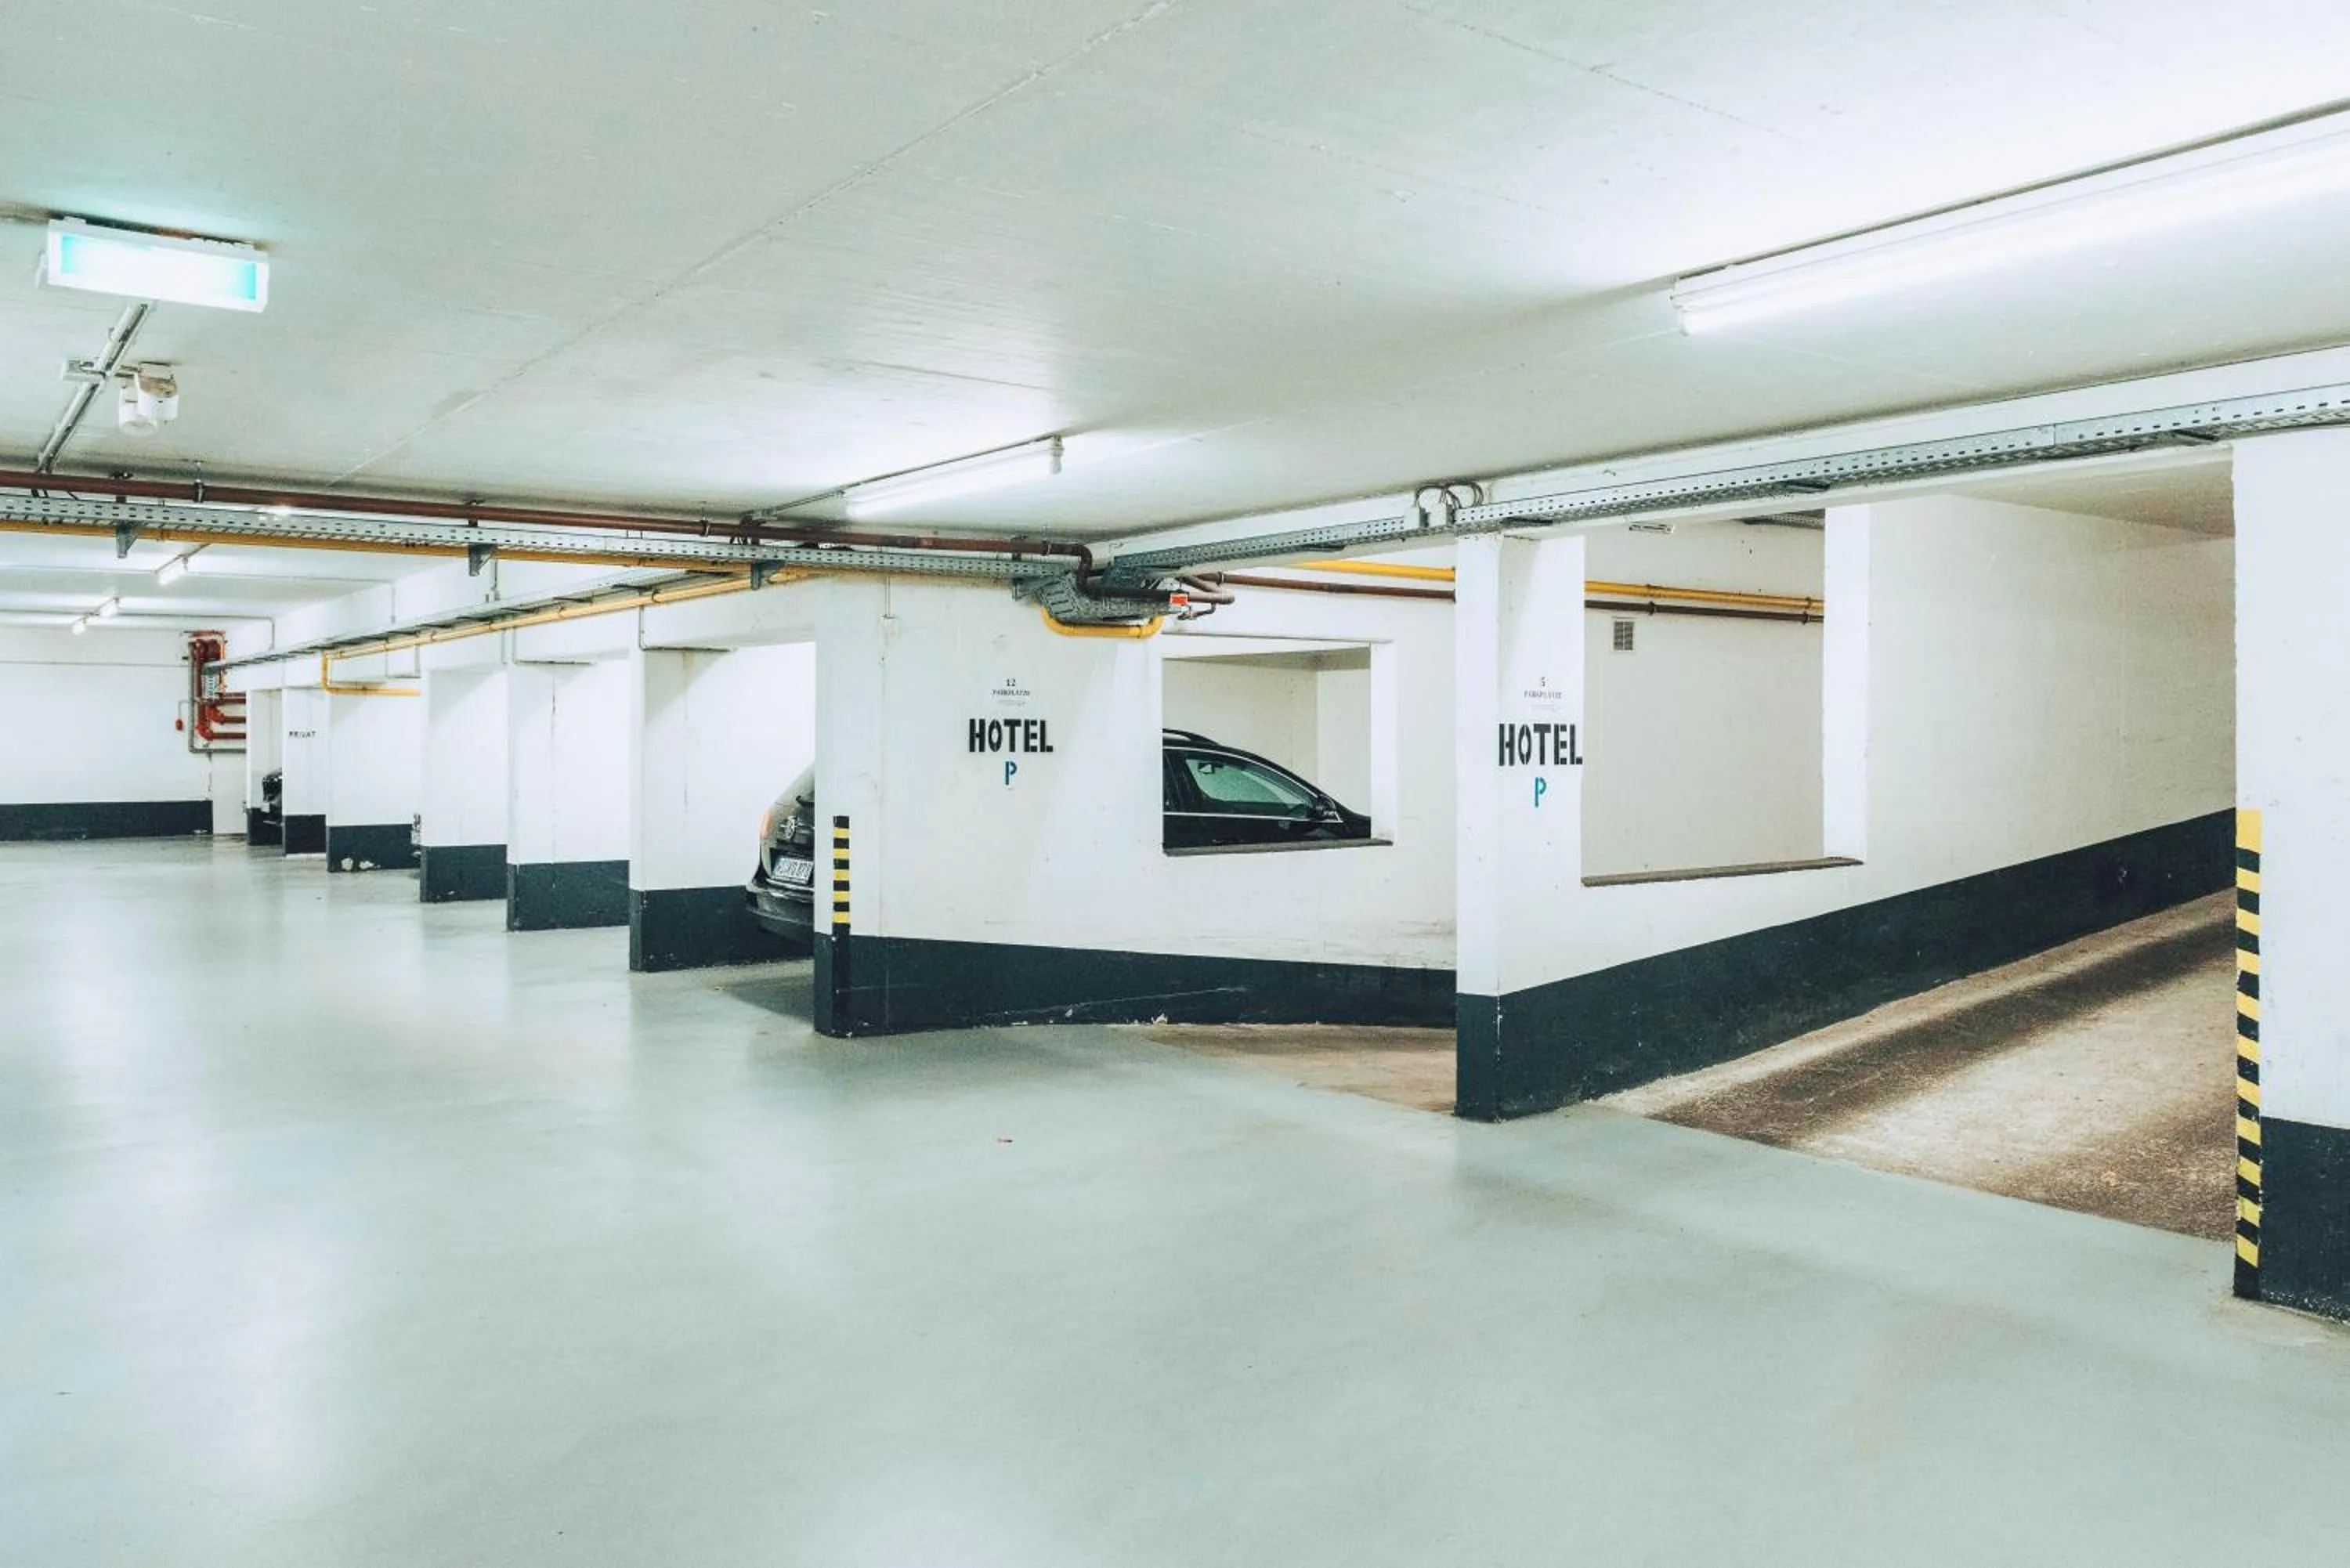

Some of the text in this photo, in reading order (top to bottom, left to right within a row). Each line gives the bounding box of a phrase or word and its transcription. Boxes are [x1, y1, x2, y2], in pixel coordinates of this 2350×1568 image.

[1006, 678, 1016, 687] 12
[288, 730, 316, 739] PRIVAT
[969, 718, 1054, 753] HOTEL
[1499, 723, 1583, 766] HOTEL
[1005, 761, 1018, 786] P
[1535, 776, 1547, 807] P
